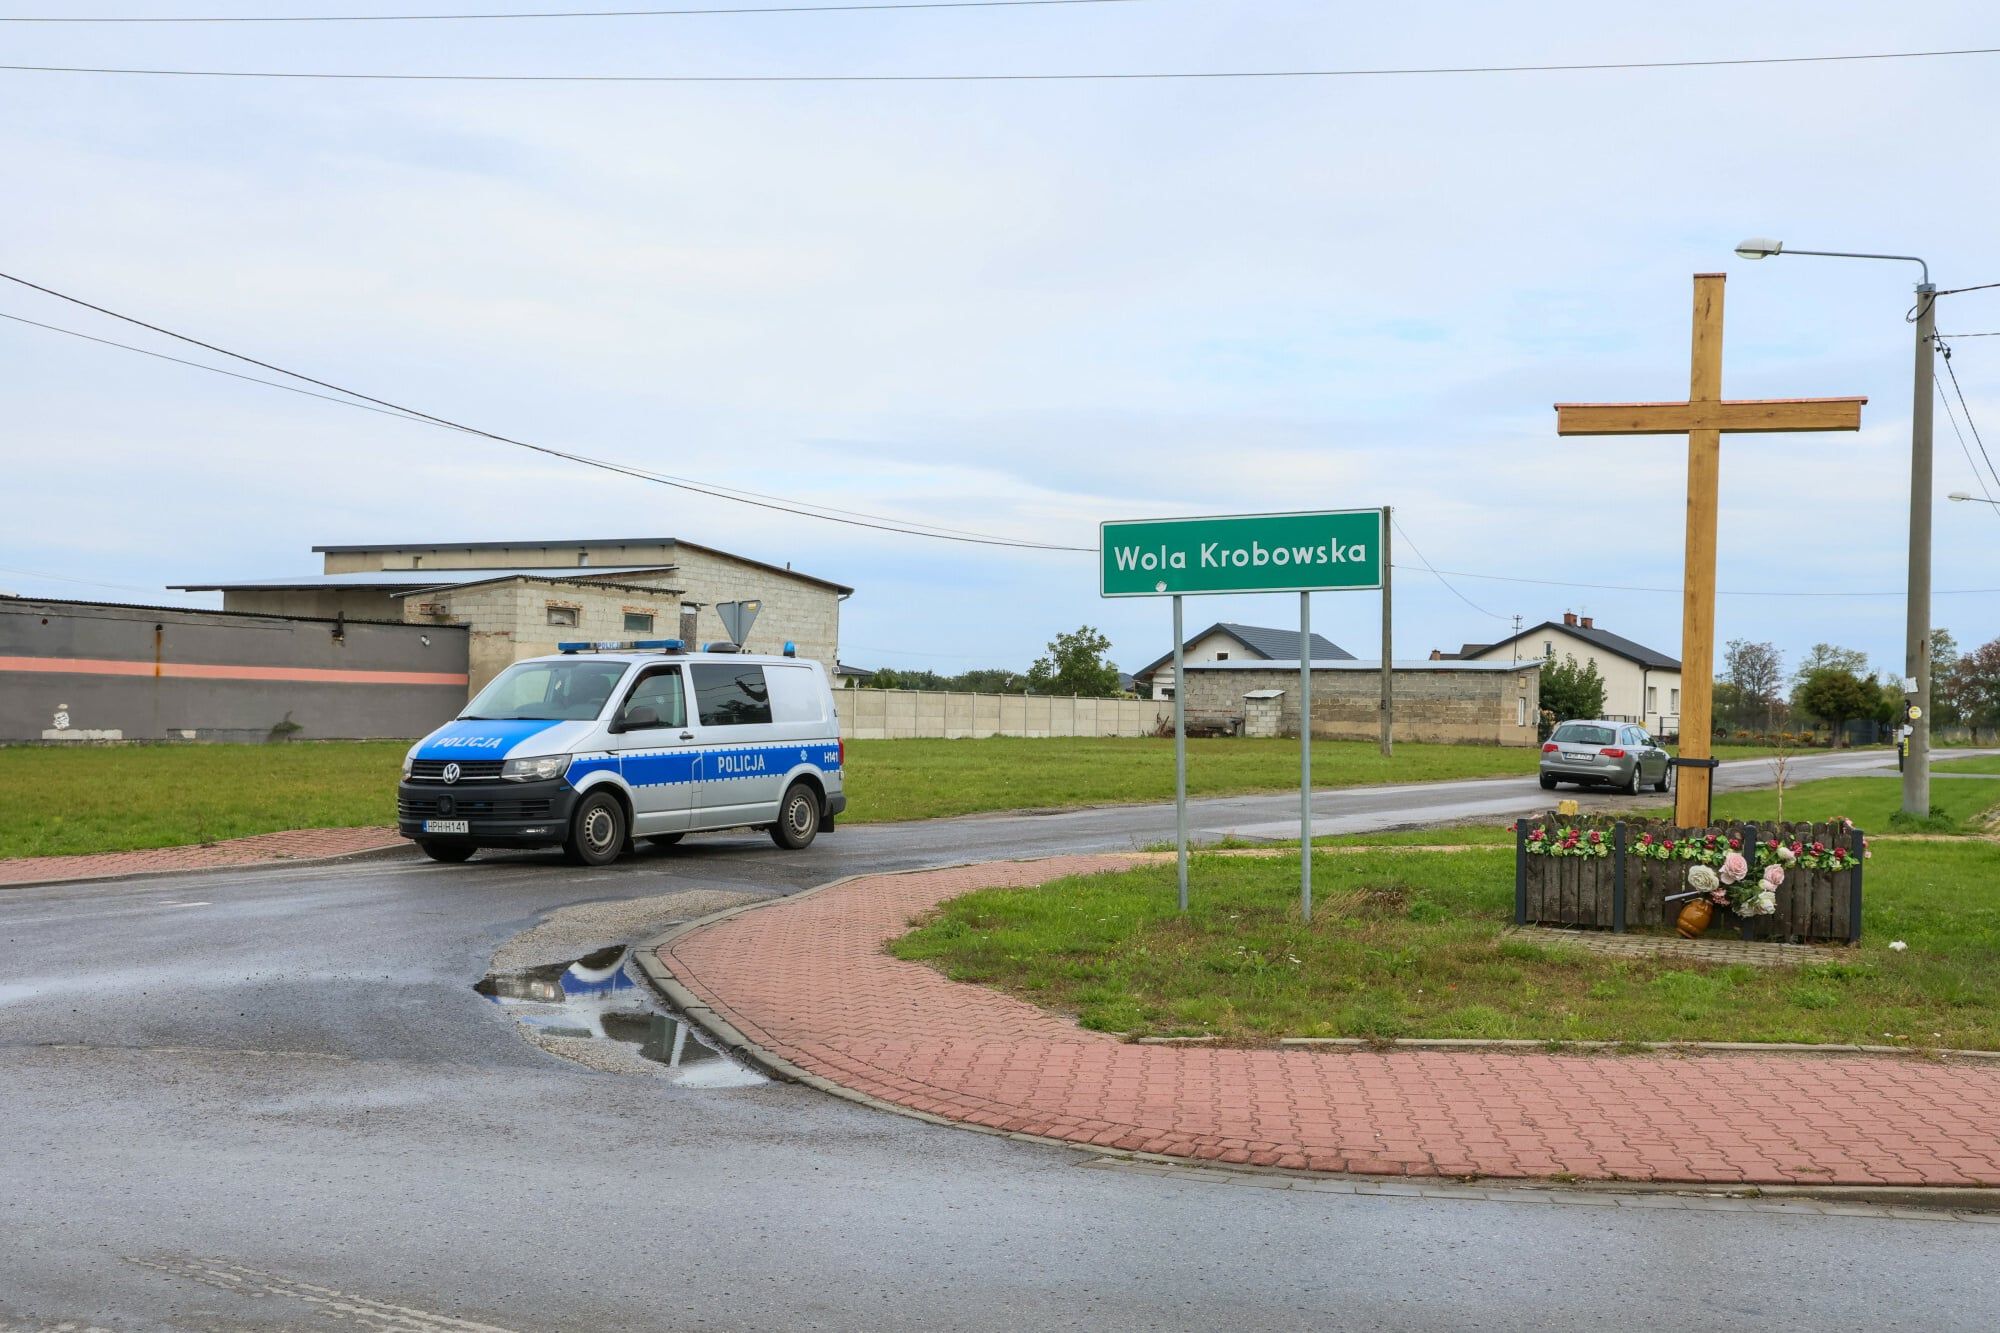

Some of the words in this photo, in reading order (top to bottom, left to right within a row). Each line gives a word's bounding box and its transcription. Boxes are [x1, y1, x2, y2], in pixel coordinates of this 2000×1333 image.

[1114, 544, 1186, 571] Wola
[1201, 537, 1367, 568] Krobowska
[432, 736, 503, 749] POLICJA
[717, 754, 766, 773] POLICJA
[823, 751, 839, 763] H141
